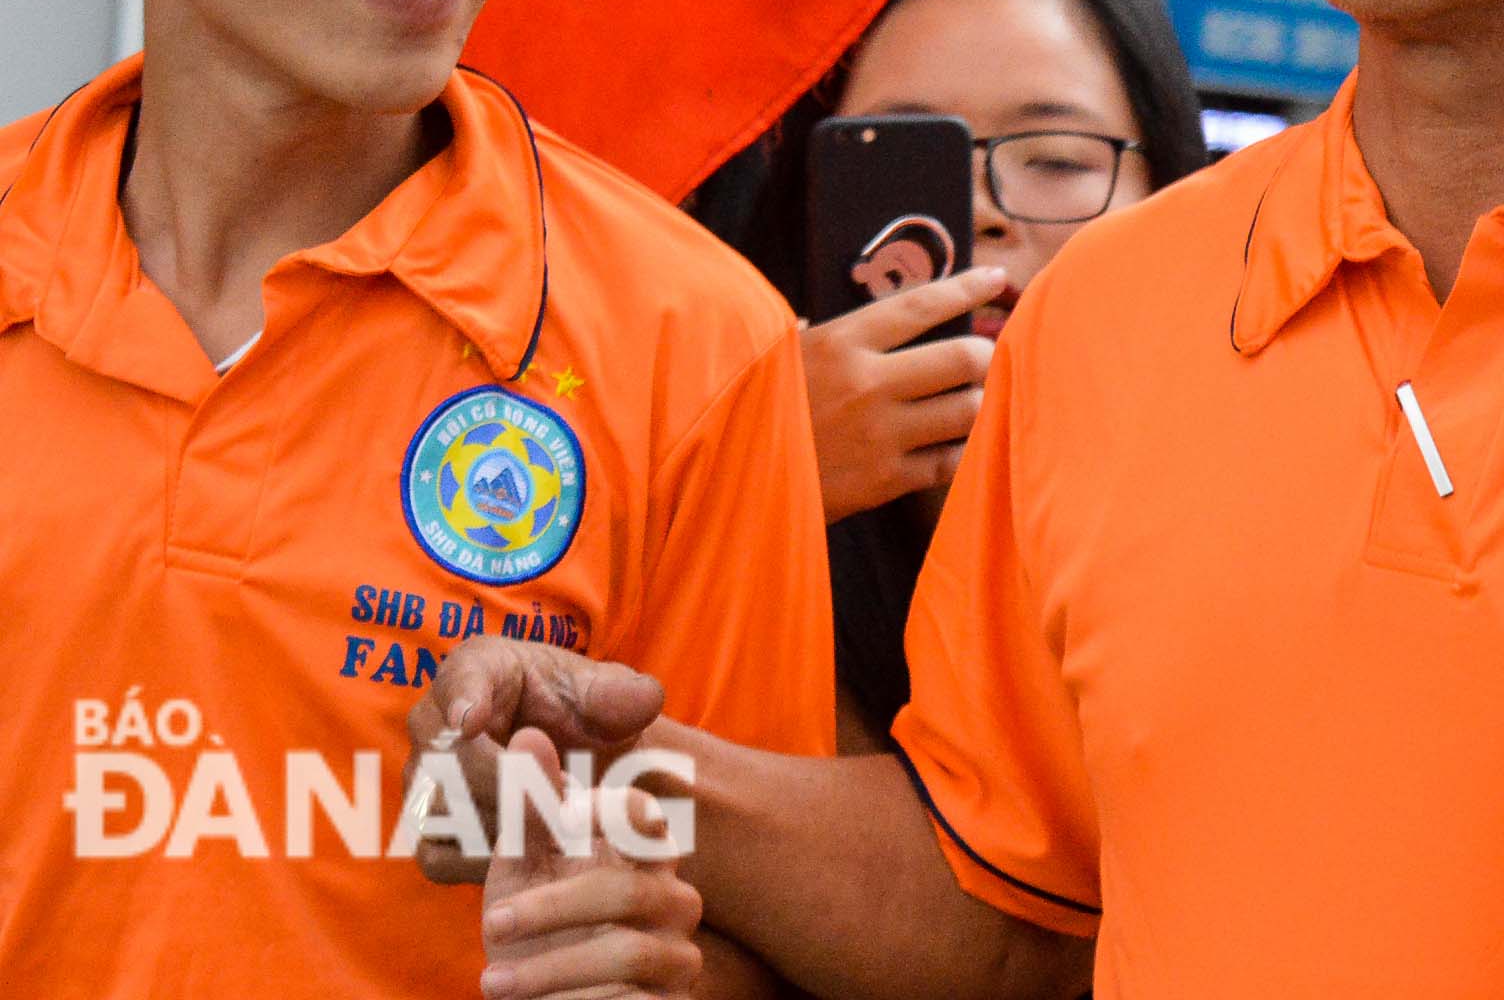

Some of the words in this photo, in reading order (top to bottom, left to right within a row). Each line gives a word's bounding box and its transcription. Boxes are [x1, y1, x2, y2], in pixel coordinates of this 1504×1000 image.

[424, 520, 458, 556] SHB
[351, 584, 426, 631] SHB
[438, 596, 485, 640] ĐÀ
